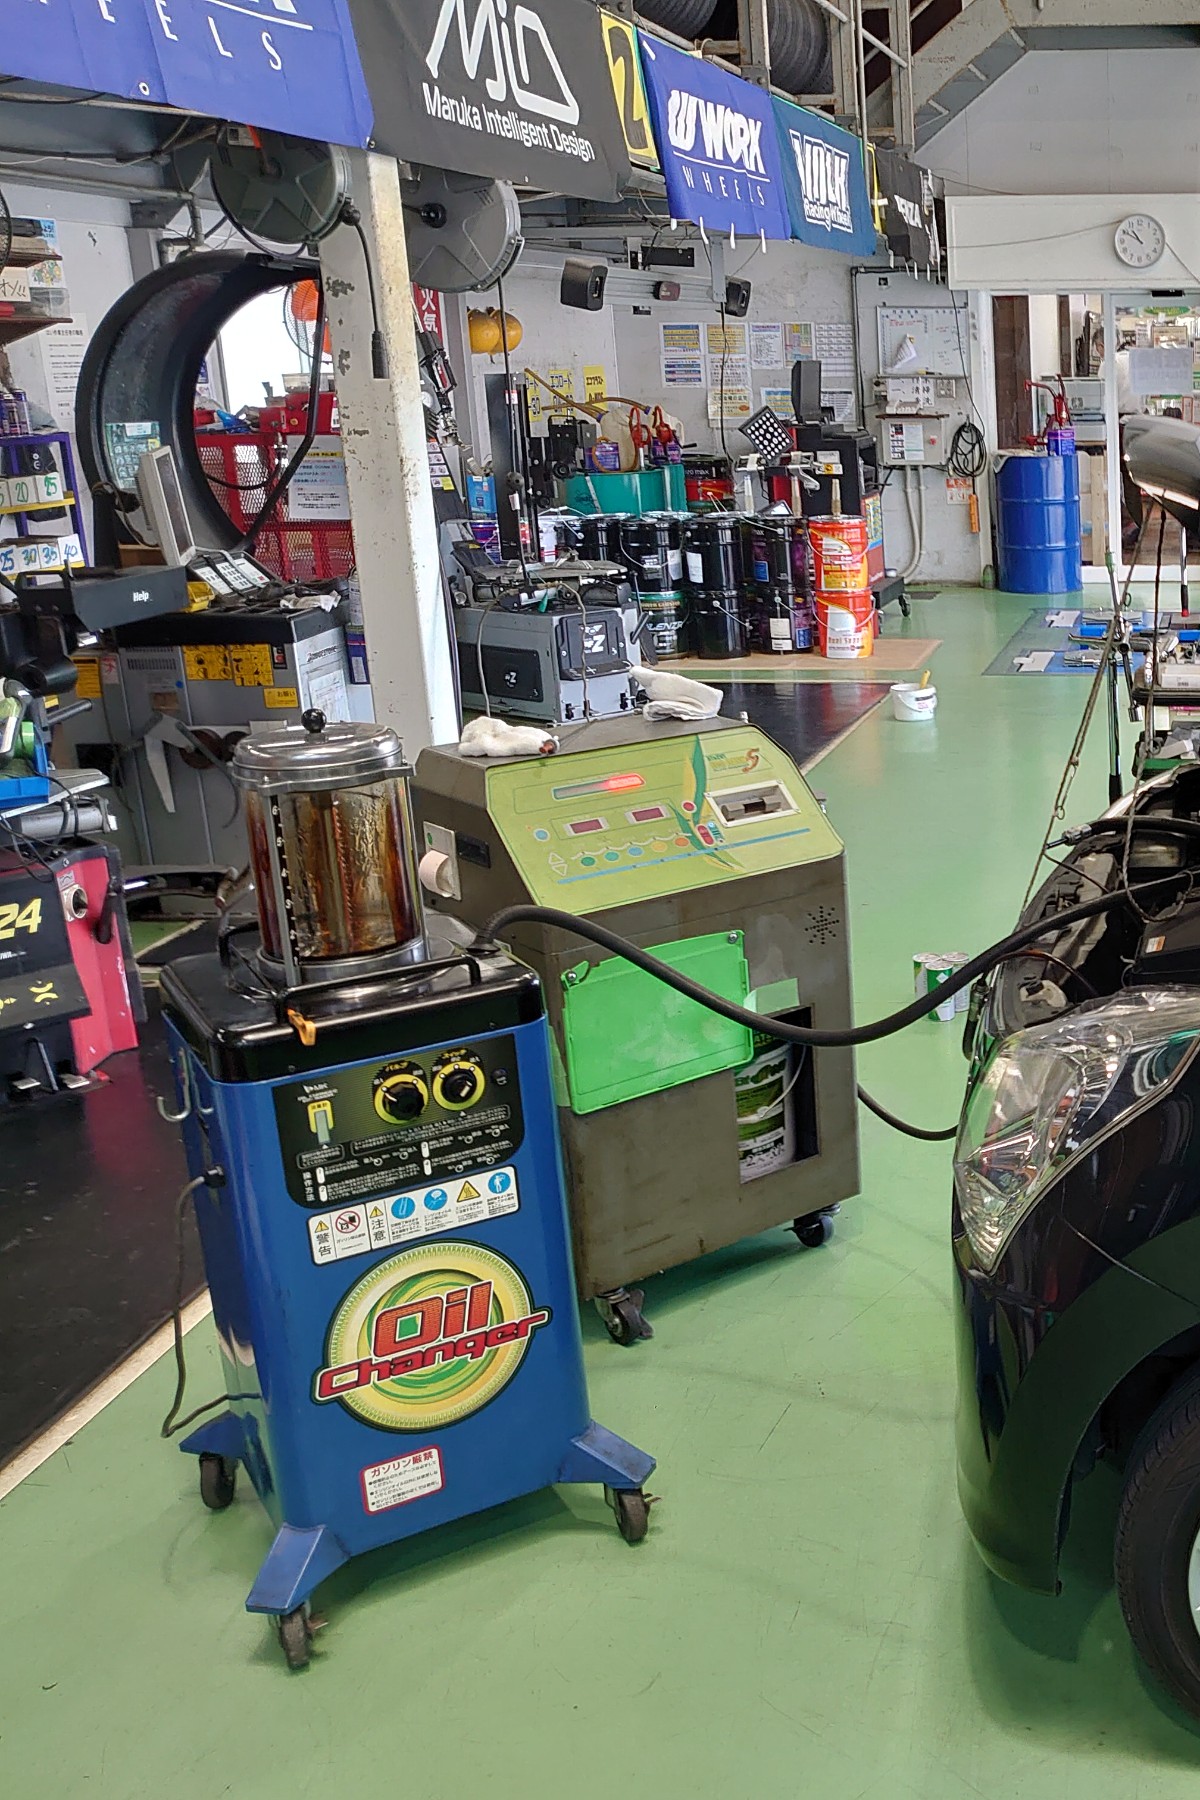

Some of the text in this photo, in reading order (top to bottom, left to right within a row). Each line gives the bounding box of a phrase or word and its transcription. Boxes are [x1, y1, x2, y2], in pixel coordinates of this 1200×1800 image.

[422, 82, 596, 162] Maruka Intelligent Design
[682, 165, 765, 206] WHEELS
[421, 287, 438, 334] 火気
[15, 481, 29, 502] 20
[0, 550, 15, 571] 25
[64, 544, 78, 559] 40
[133, 590, 149, 602] Help
[272, 805, 278, 815] 6
[371, 1219, 386, 1242] 注意
[316, 1232, 331, 1257] 警告
[371, 1280, 493, 1358] Oil
[317, 1311, 548, 1399] Changer
[371, 1451, 434, 1478] ガソリン厳禁
